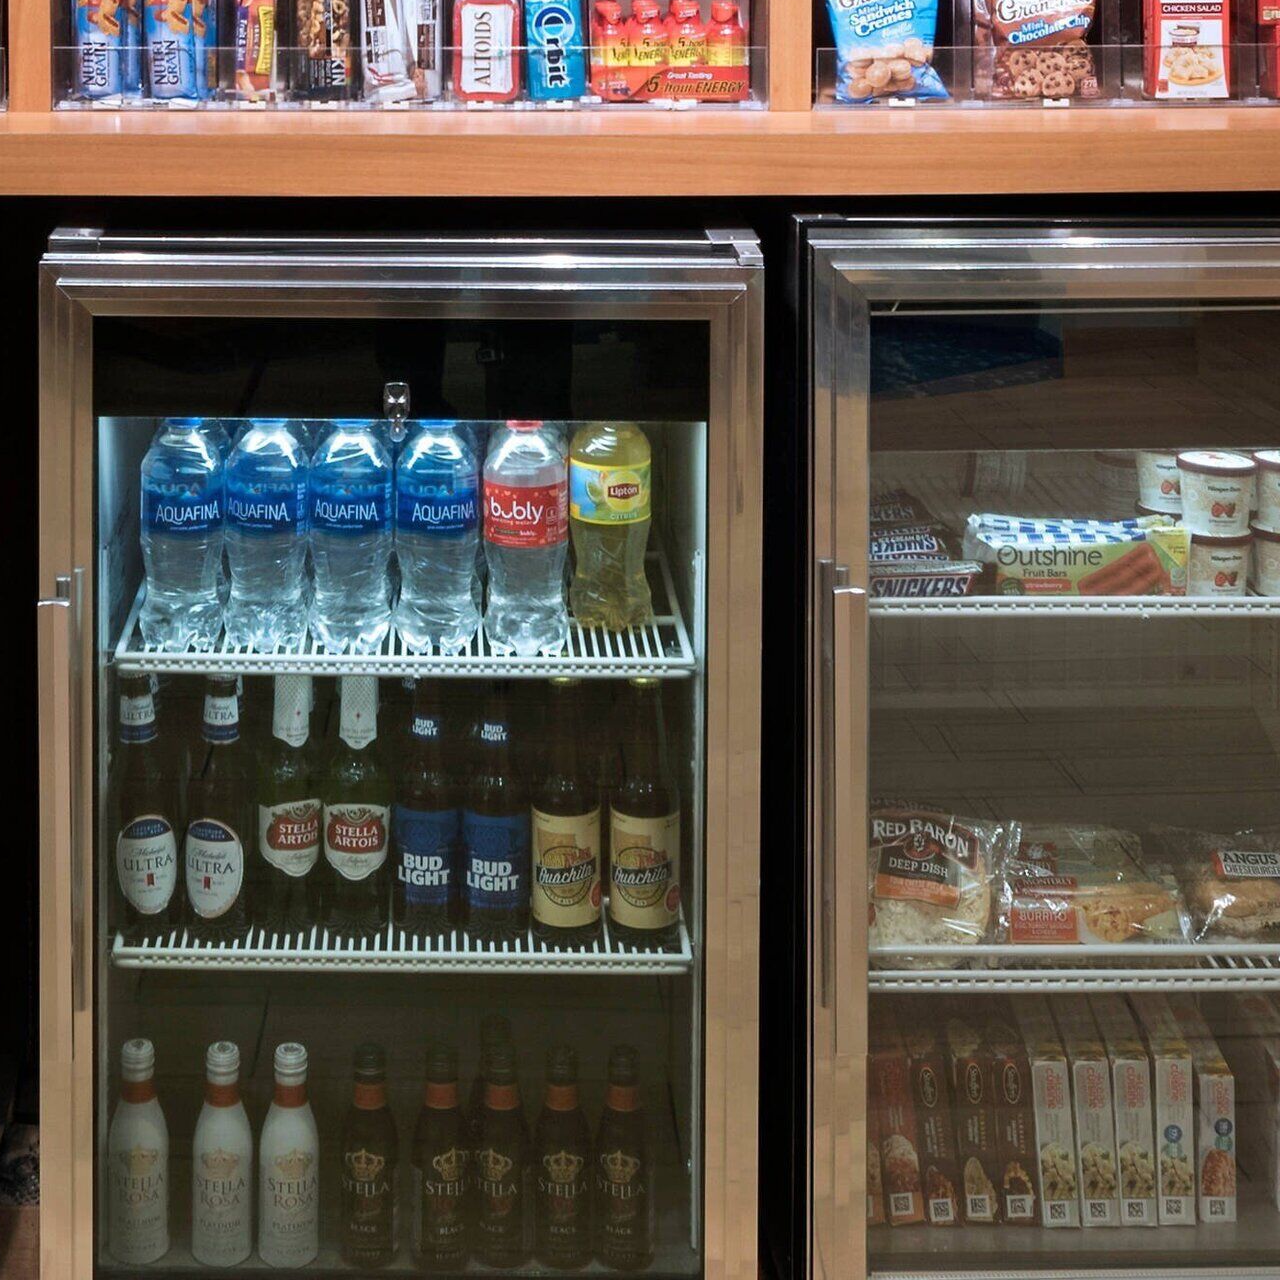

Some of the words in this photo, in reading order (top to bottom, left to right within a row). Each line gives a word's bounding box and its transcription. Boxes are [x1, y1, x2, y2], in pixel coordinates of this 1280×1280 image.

[854, 9, 913, 37] Cremes
[1008, 21, 1065, 44] Chocolate
[1065, 14, 1091, 28] Chip
[1021, 19, 1045, 33] Mini
[473, 9, 493, 87] ALTOIDS
[531, 4, 576, 88] Orbit
[82, 41, 93, 86] NUTRI
[93, 41, 107, 87] GRAIN
[152, 40, 165, 86] NUTRI
[165, 39, 179, 86] GRAIN
[694, 80, 745, 94] ENERGY
[609, 485, 638, 498] Lipton
[155, 500, 220, 526] AQUAFINA
[227, 496, 291, 525] AQUAFINA
[315, 498, 380, 525] AQUAFINA
[412, 500, 476, 524] AQUAFINA
[489, 496, 544, 530] bubly
[997, 544, 1103, 567] Outshine
[1022, 568, 1044, 578] Fruit
[1046, 568, 1068, 578] Bars
[871, 576, 969, 597] SNICKERS
[412, 725, 439, 737] LIGHT
[415, 718, 435, 729] BUD
[483, 723, 504, 734] BUD
[480, 730, 508, 742] LIGHT
[279, 819, 319, 834] STELLA
[334, 824, 379, 838] STELLA
[333, 836, 379, 849] ARTOIS
[872, 819, 907, 840] RED
[909, 819, 970, 859] BARON
[122, 855, 174, 873] ULTRA
[186, 857, 236, 875] ULTRA
[403, 852, 443, 871] BUD
[471, 857, 513, 877] BUD
[888, 856, 919, 872] DEEP
[921, 860, 949, 879] DISH
[1222, 852, 1280, 866] ANGUS
[398, 865, 450, 887] LIGHT
[466, 870, 519, 892] LIGHT
[538, 864, 593, 886] Ouachita
[614, 865, 668, 886] Ouachita
[1018, 909, 1068, 922] BURRITO
[195, 1174, 247, 1198] STELLA
[268, 1174, 319, 1198] STELLA
[199, 1192, 242, 1210] ROSA
[273, 1193, 314, 1210] ROSA
